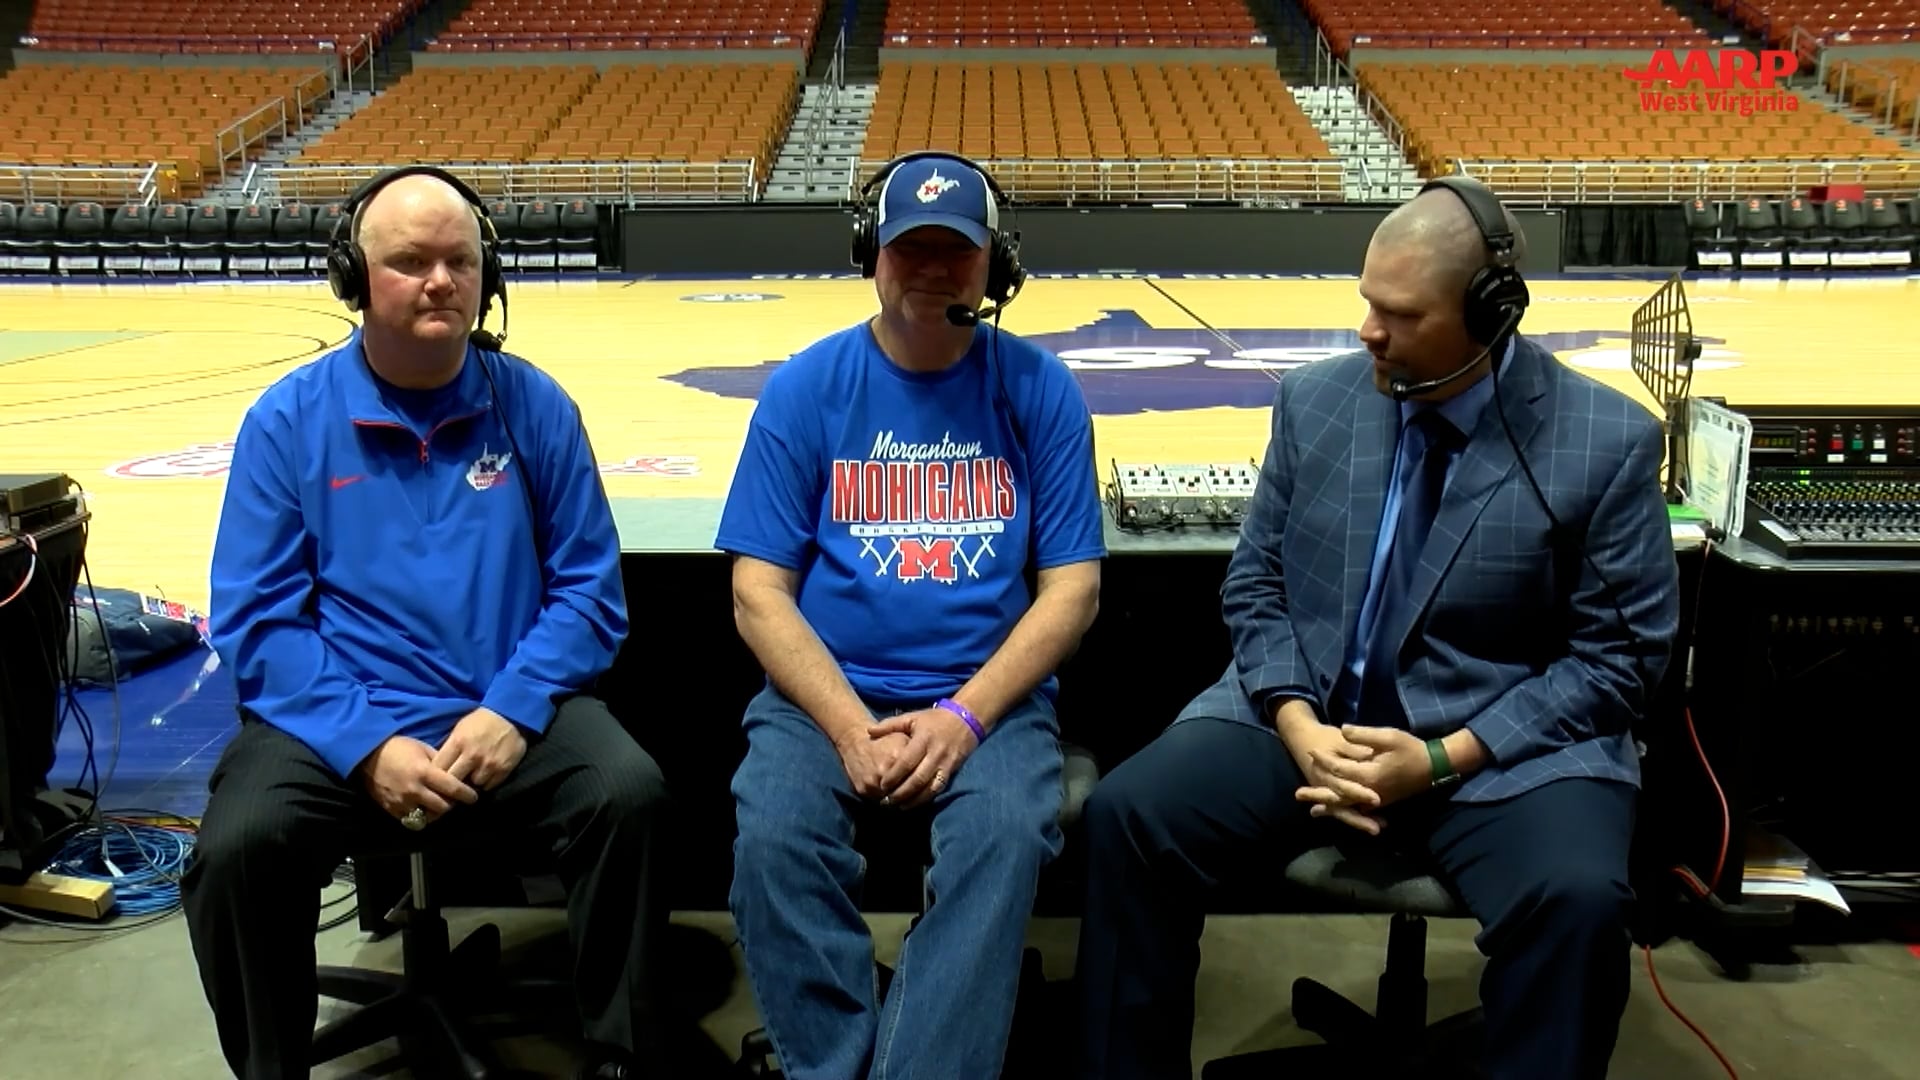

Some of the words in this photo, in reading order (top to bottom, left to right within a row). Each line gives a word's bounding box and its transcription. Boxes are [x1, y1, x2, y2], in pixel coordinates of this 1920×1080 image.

[924, 185, 939, 196] M
[869, 430, 982, 462] Morgantown
[832, 457, 1017, 523] MOHIGANS
[897, 538, 957, 579] M
